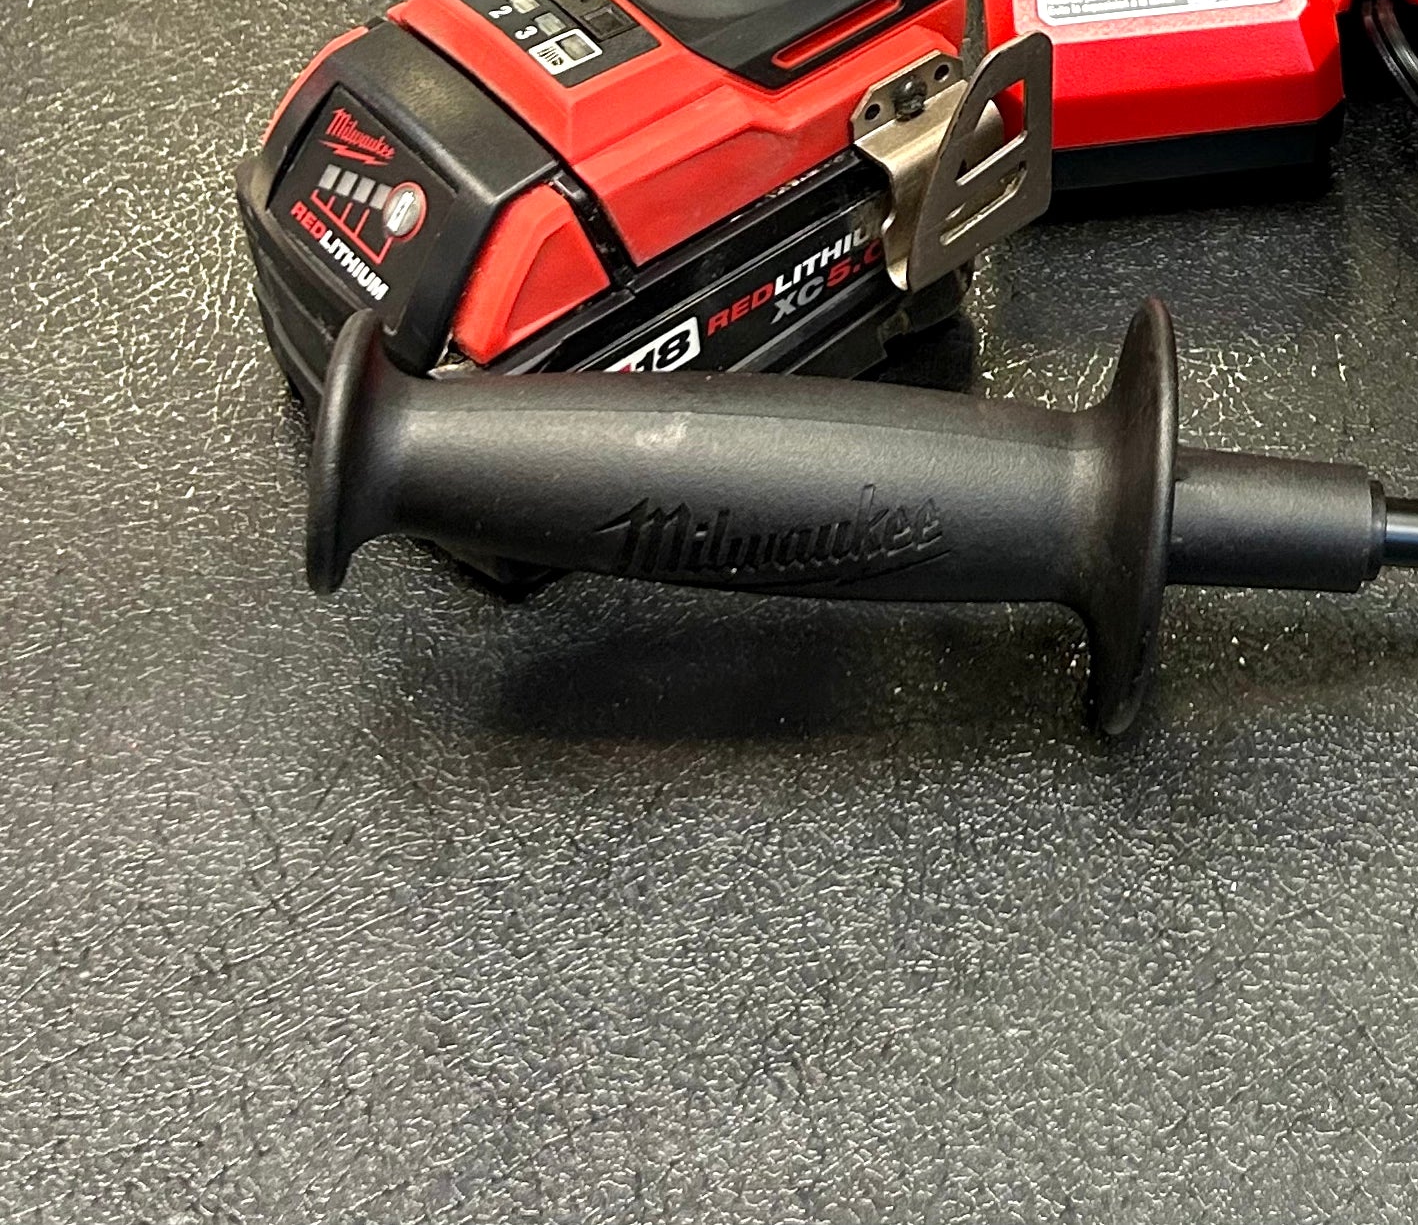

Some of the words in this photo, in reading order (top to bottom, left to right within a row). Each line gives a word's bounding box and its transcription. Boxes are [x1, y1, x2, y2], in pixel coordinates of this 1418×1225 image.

[488, 5, 513, 19] 2
[515, 25, 538, 40] 3
[325, 107, 396, 160] Milwaukee
[618, 329, 691, 372] 18
[707, 227, 873, 338] REDLITHIU
[595, 483, 943, 575] Milwaukee
